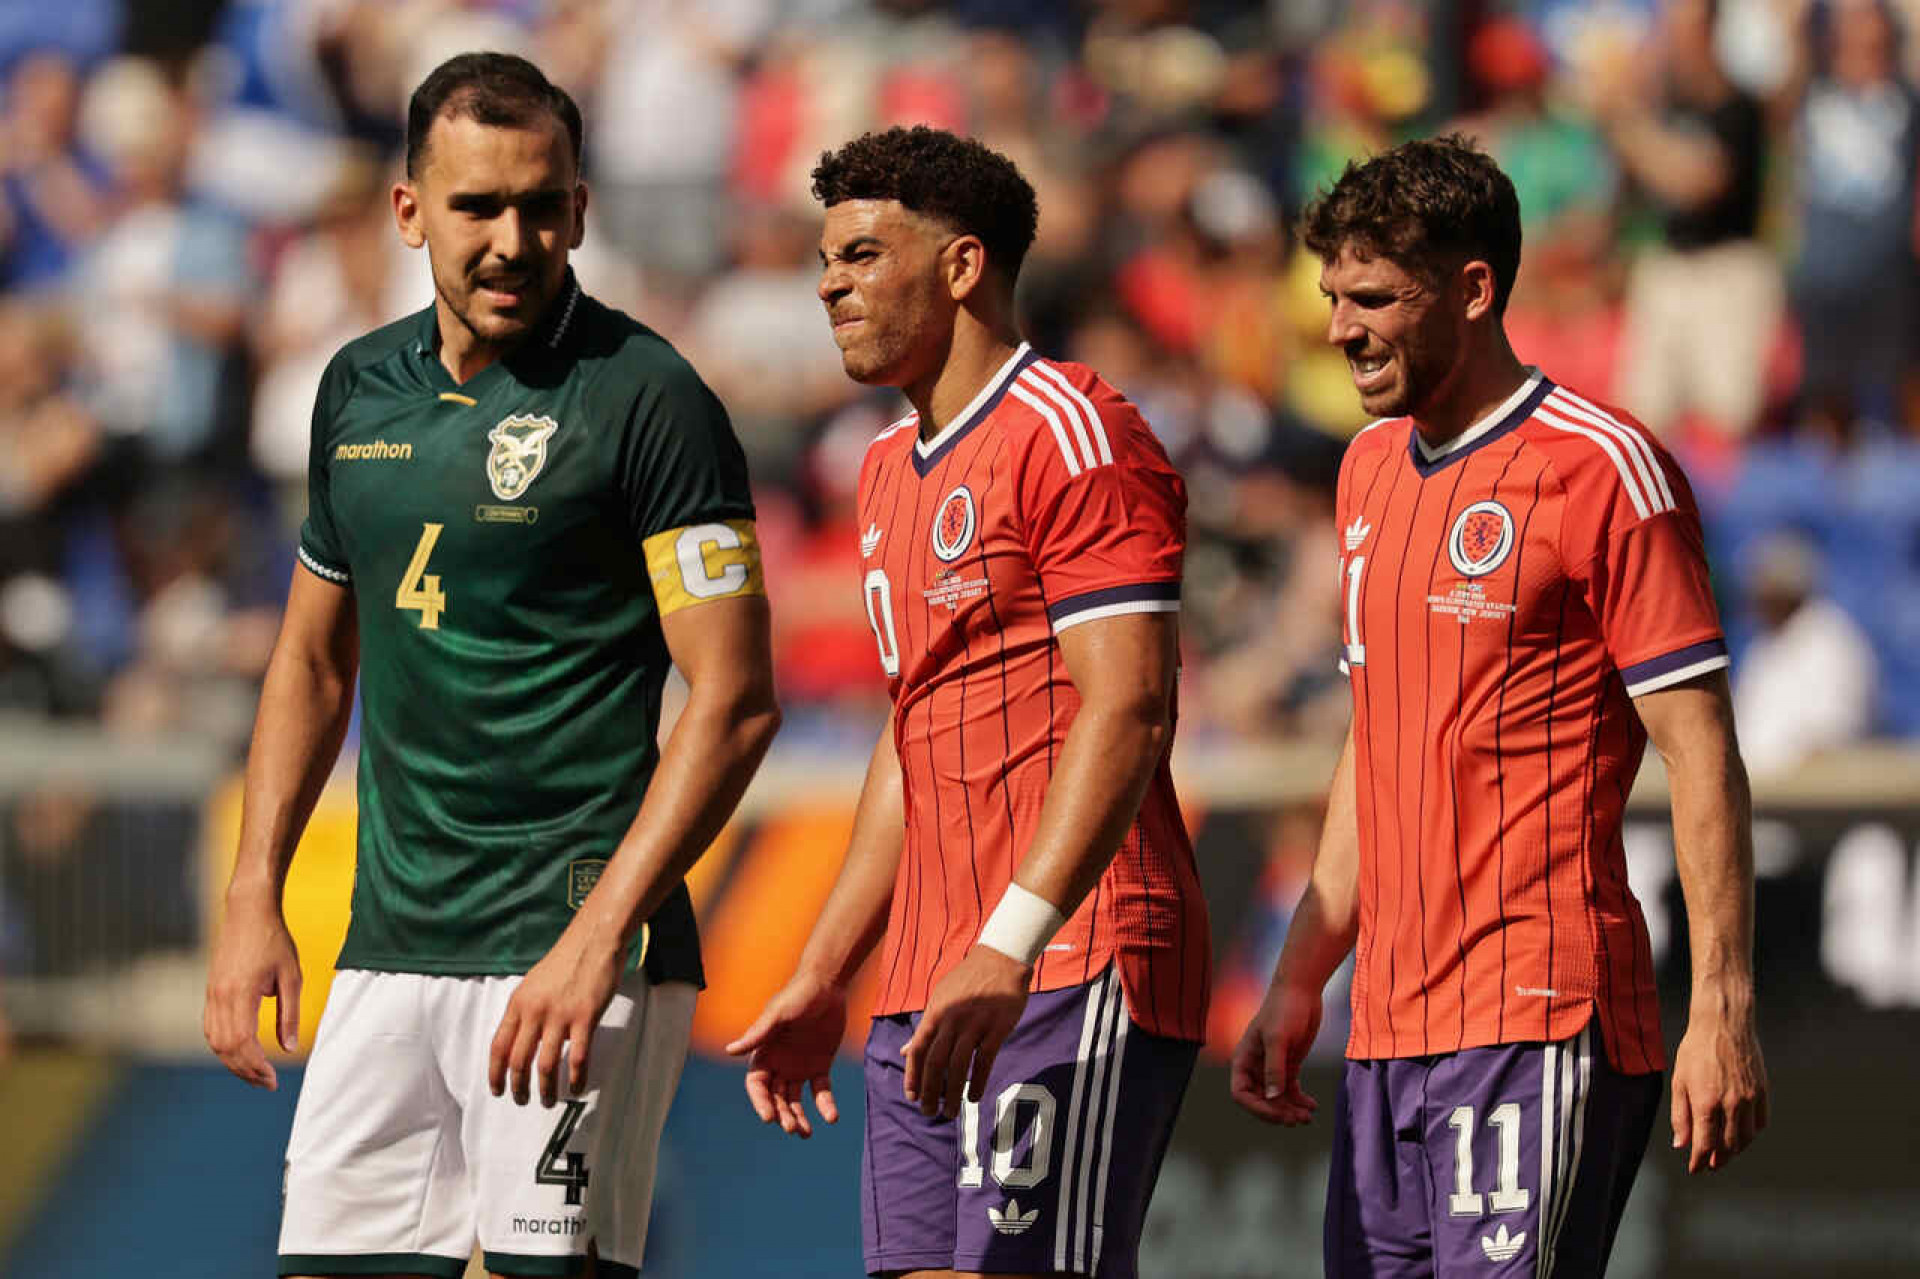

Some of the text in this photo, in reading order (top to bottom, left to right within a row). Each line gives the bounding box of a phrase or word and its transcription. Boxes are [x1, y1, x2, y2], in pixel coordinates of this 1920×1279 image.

[335, 440, 412, 461] marathon
[396, 523, 446, 629] 4
[676, 523, 749, 599] C
[1339, 556, 1366, 667] 1
[864, 569, 900, 677] 0
[535, 1100, 588, 1205] 4
[958, 1081, 1057, 1189] 10
[1449, 1103, 1530, 1217] 11
[513, 1216, 587, 1237] marath
